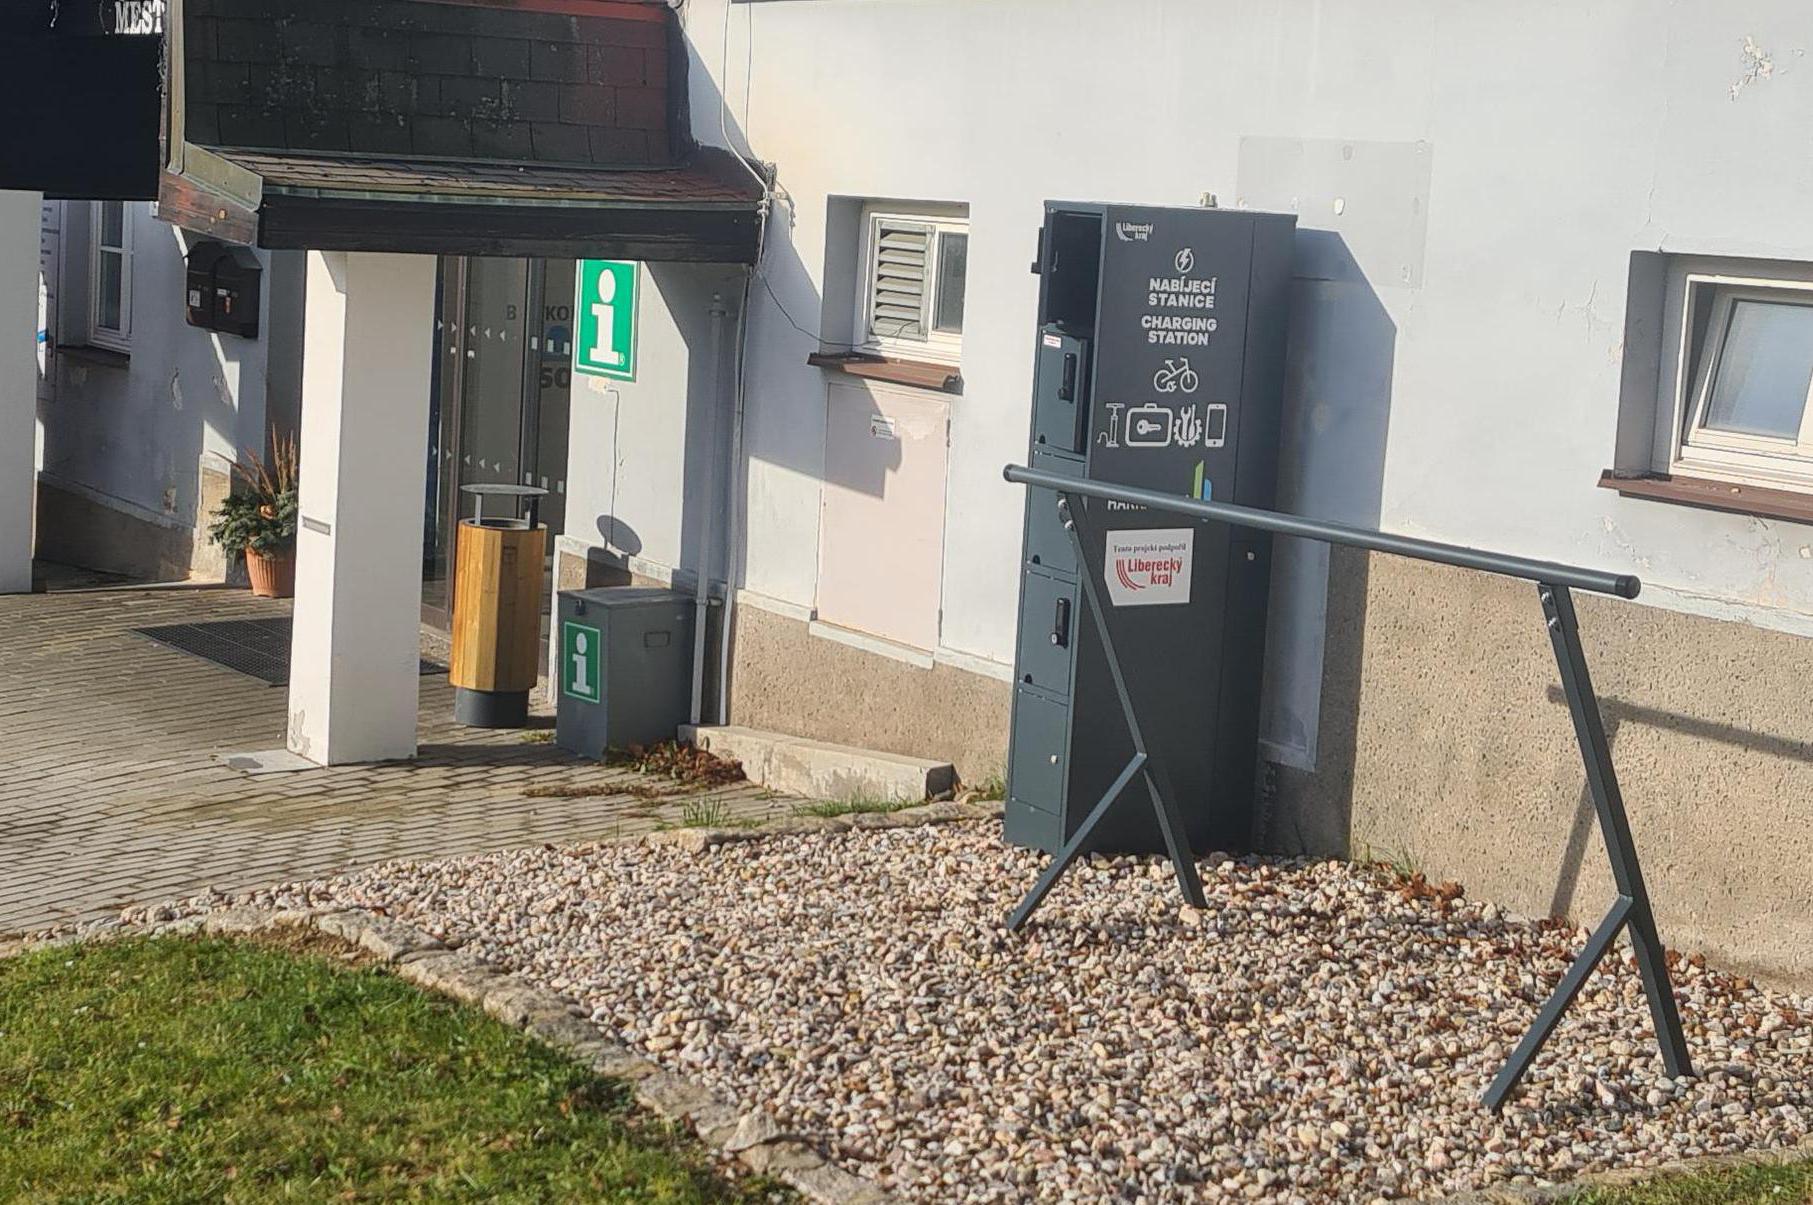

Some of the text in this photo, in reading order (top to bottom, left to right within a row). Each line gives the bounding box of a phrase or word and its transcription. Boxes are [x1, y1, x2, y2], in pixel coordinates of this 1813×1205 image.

[1149, 276, 1218, 294] NABÍJECÍ
[1148, 292, 1215, 309] STANICE
[1141, 315, 1218, 332] CHARGING
[1148, 330, 1210, 346] STATION
[1128, 557, 1183, 574] Liberecký
[1150, 571, 1174, 587] kraj
